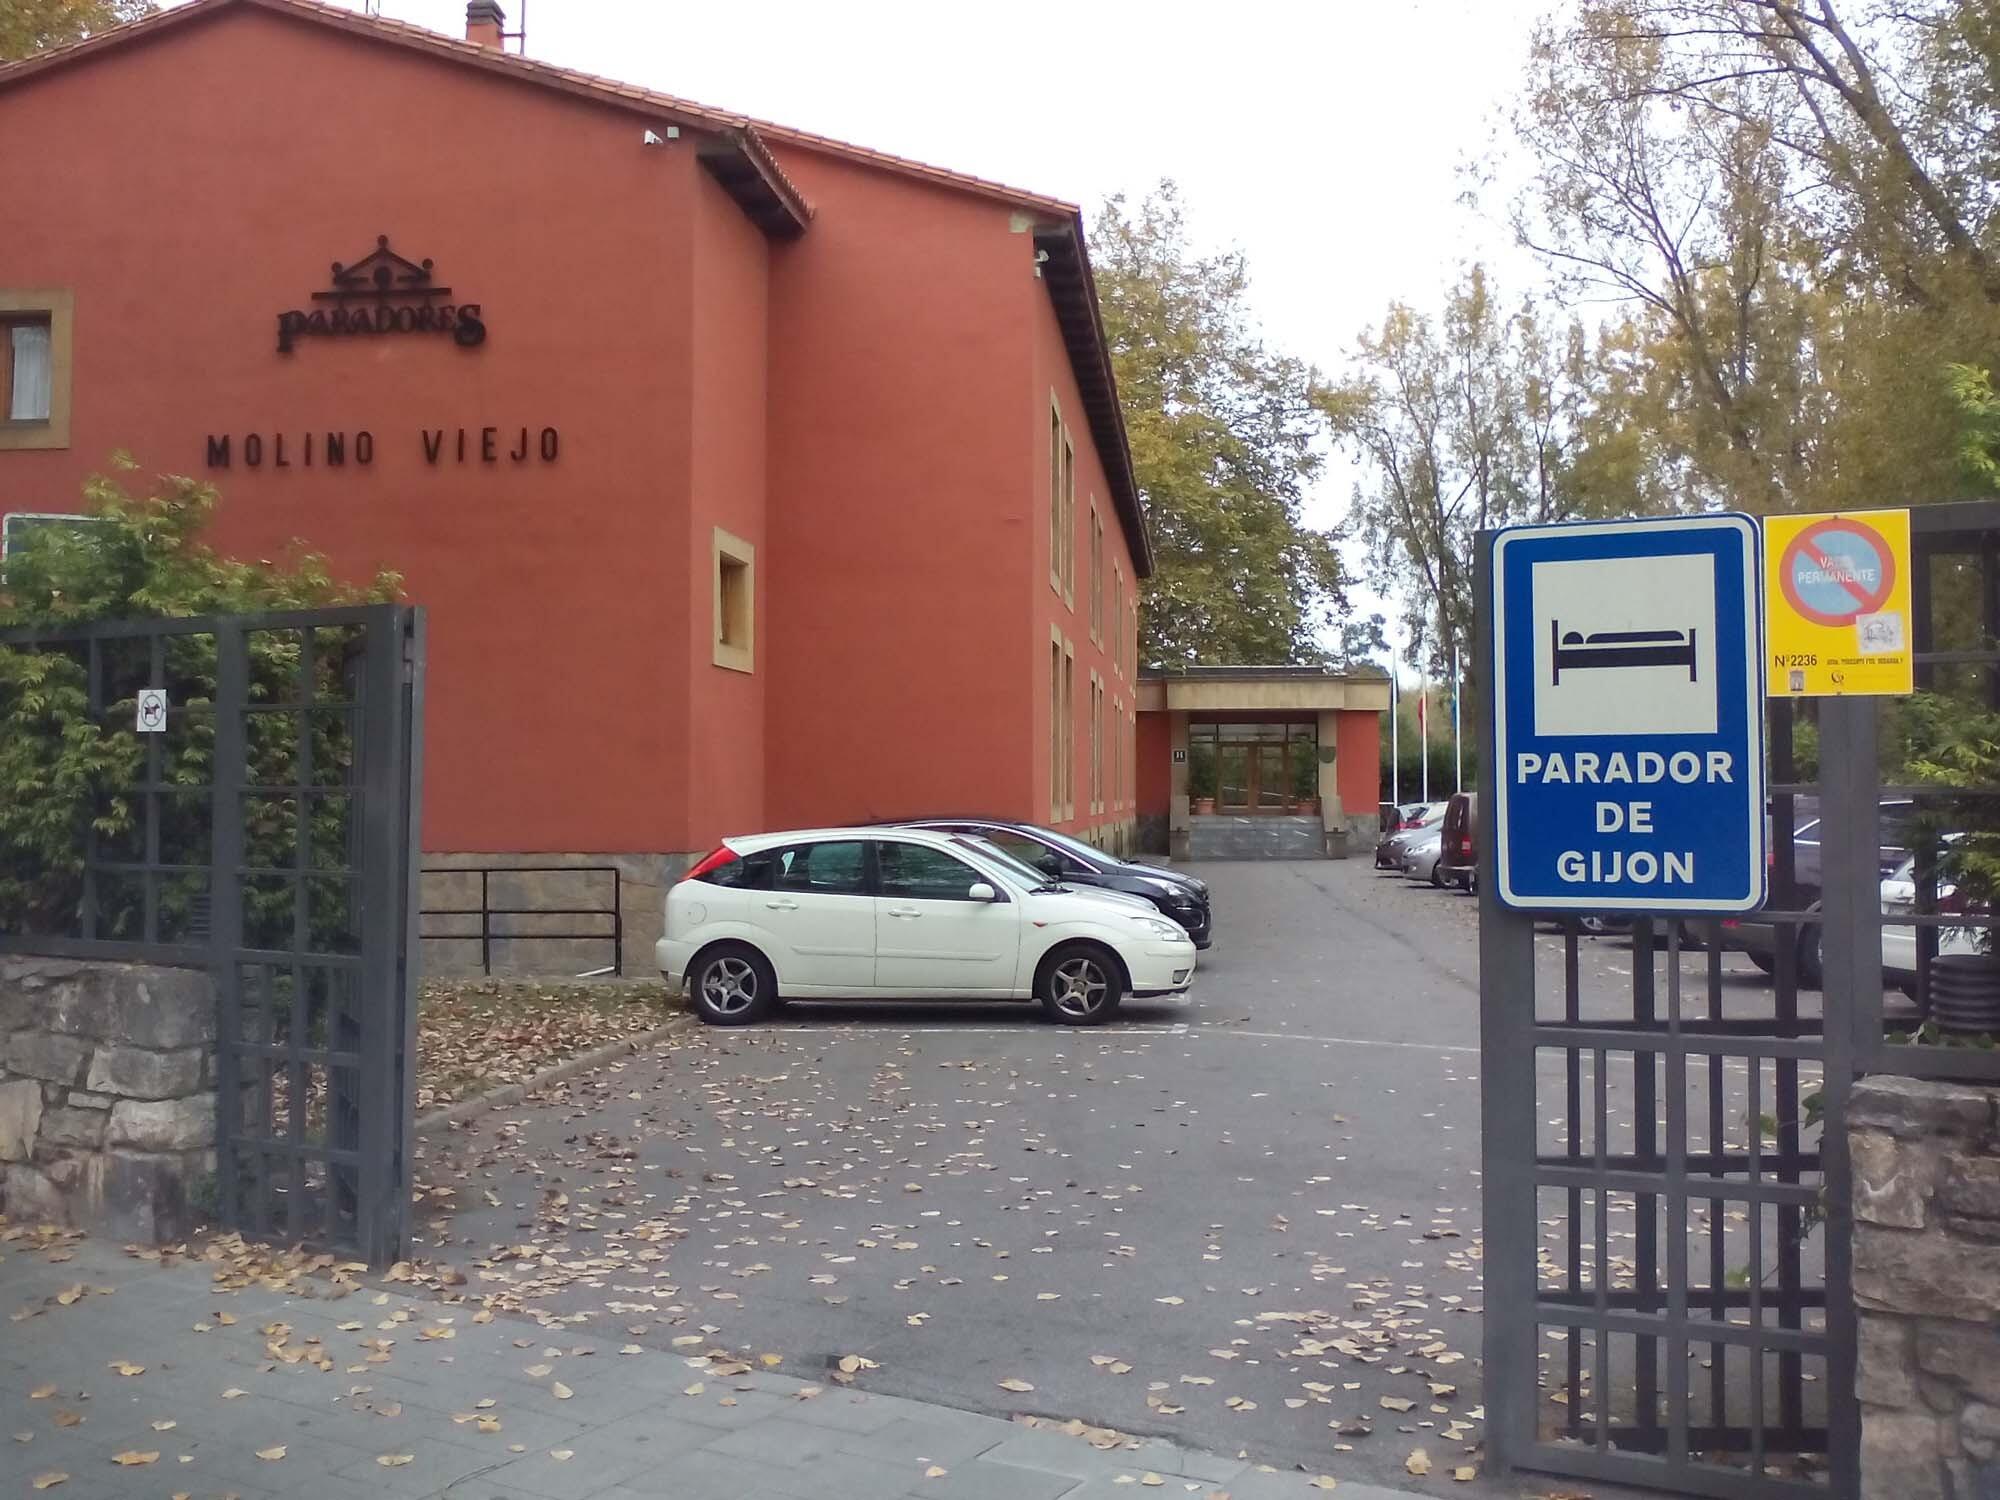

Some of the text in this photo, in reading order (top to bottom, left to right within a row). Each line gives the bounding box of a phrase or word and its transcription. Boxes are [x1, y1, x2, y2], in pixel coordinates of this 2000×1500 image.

[276, 303, 486, 353] PARADORES
[207, 427, 559, 468] MOLINO VIEJO
[1517, 751, 1734, 784] PARADOR
[1596, 801, 1653, 833] DE
[1556, 850, 1694, 884] GIJON
